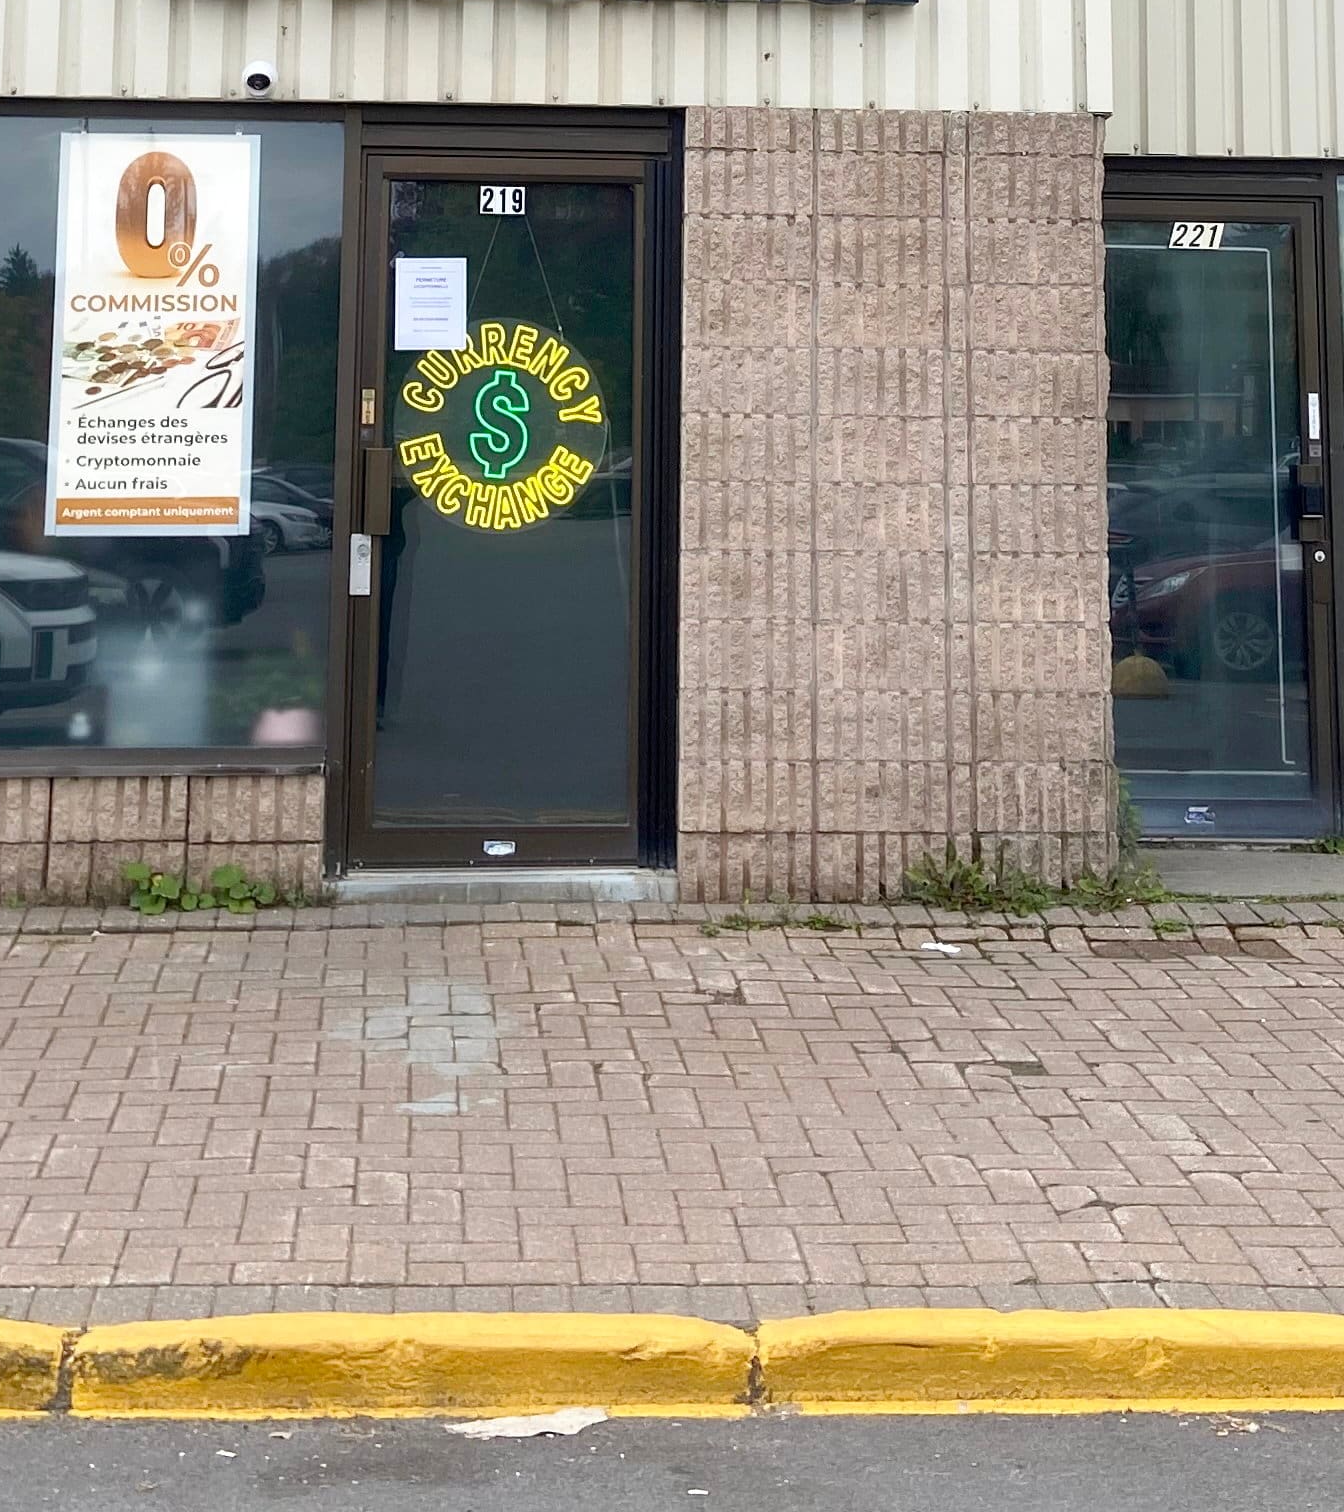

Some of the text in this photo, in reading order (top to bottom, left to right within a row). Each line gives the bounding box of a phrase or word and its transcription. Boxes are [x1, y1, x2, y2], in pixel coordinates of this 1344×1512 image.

[481, 187, 524, 213] 219
[1172, 223, 1218, 247] 221
[70, 294, 239, 314] COMMISSION
[402, 321, 604, 424] CURRENCY
[78, 413, 189, 431] Échanges des
[77, 431, 228, 446] devises étrangères
[76, 453, 201, 470] Cryptomonnaie
[74, 477, 168, 490] Aucun frais
[398, 432, 595, 531] EXCHANGE
[62, 506, 234, 520] Argent comptant uniquement
